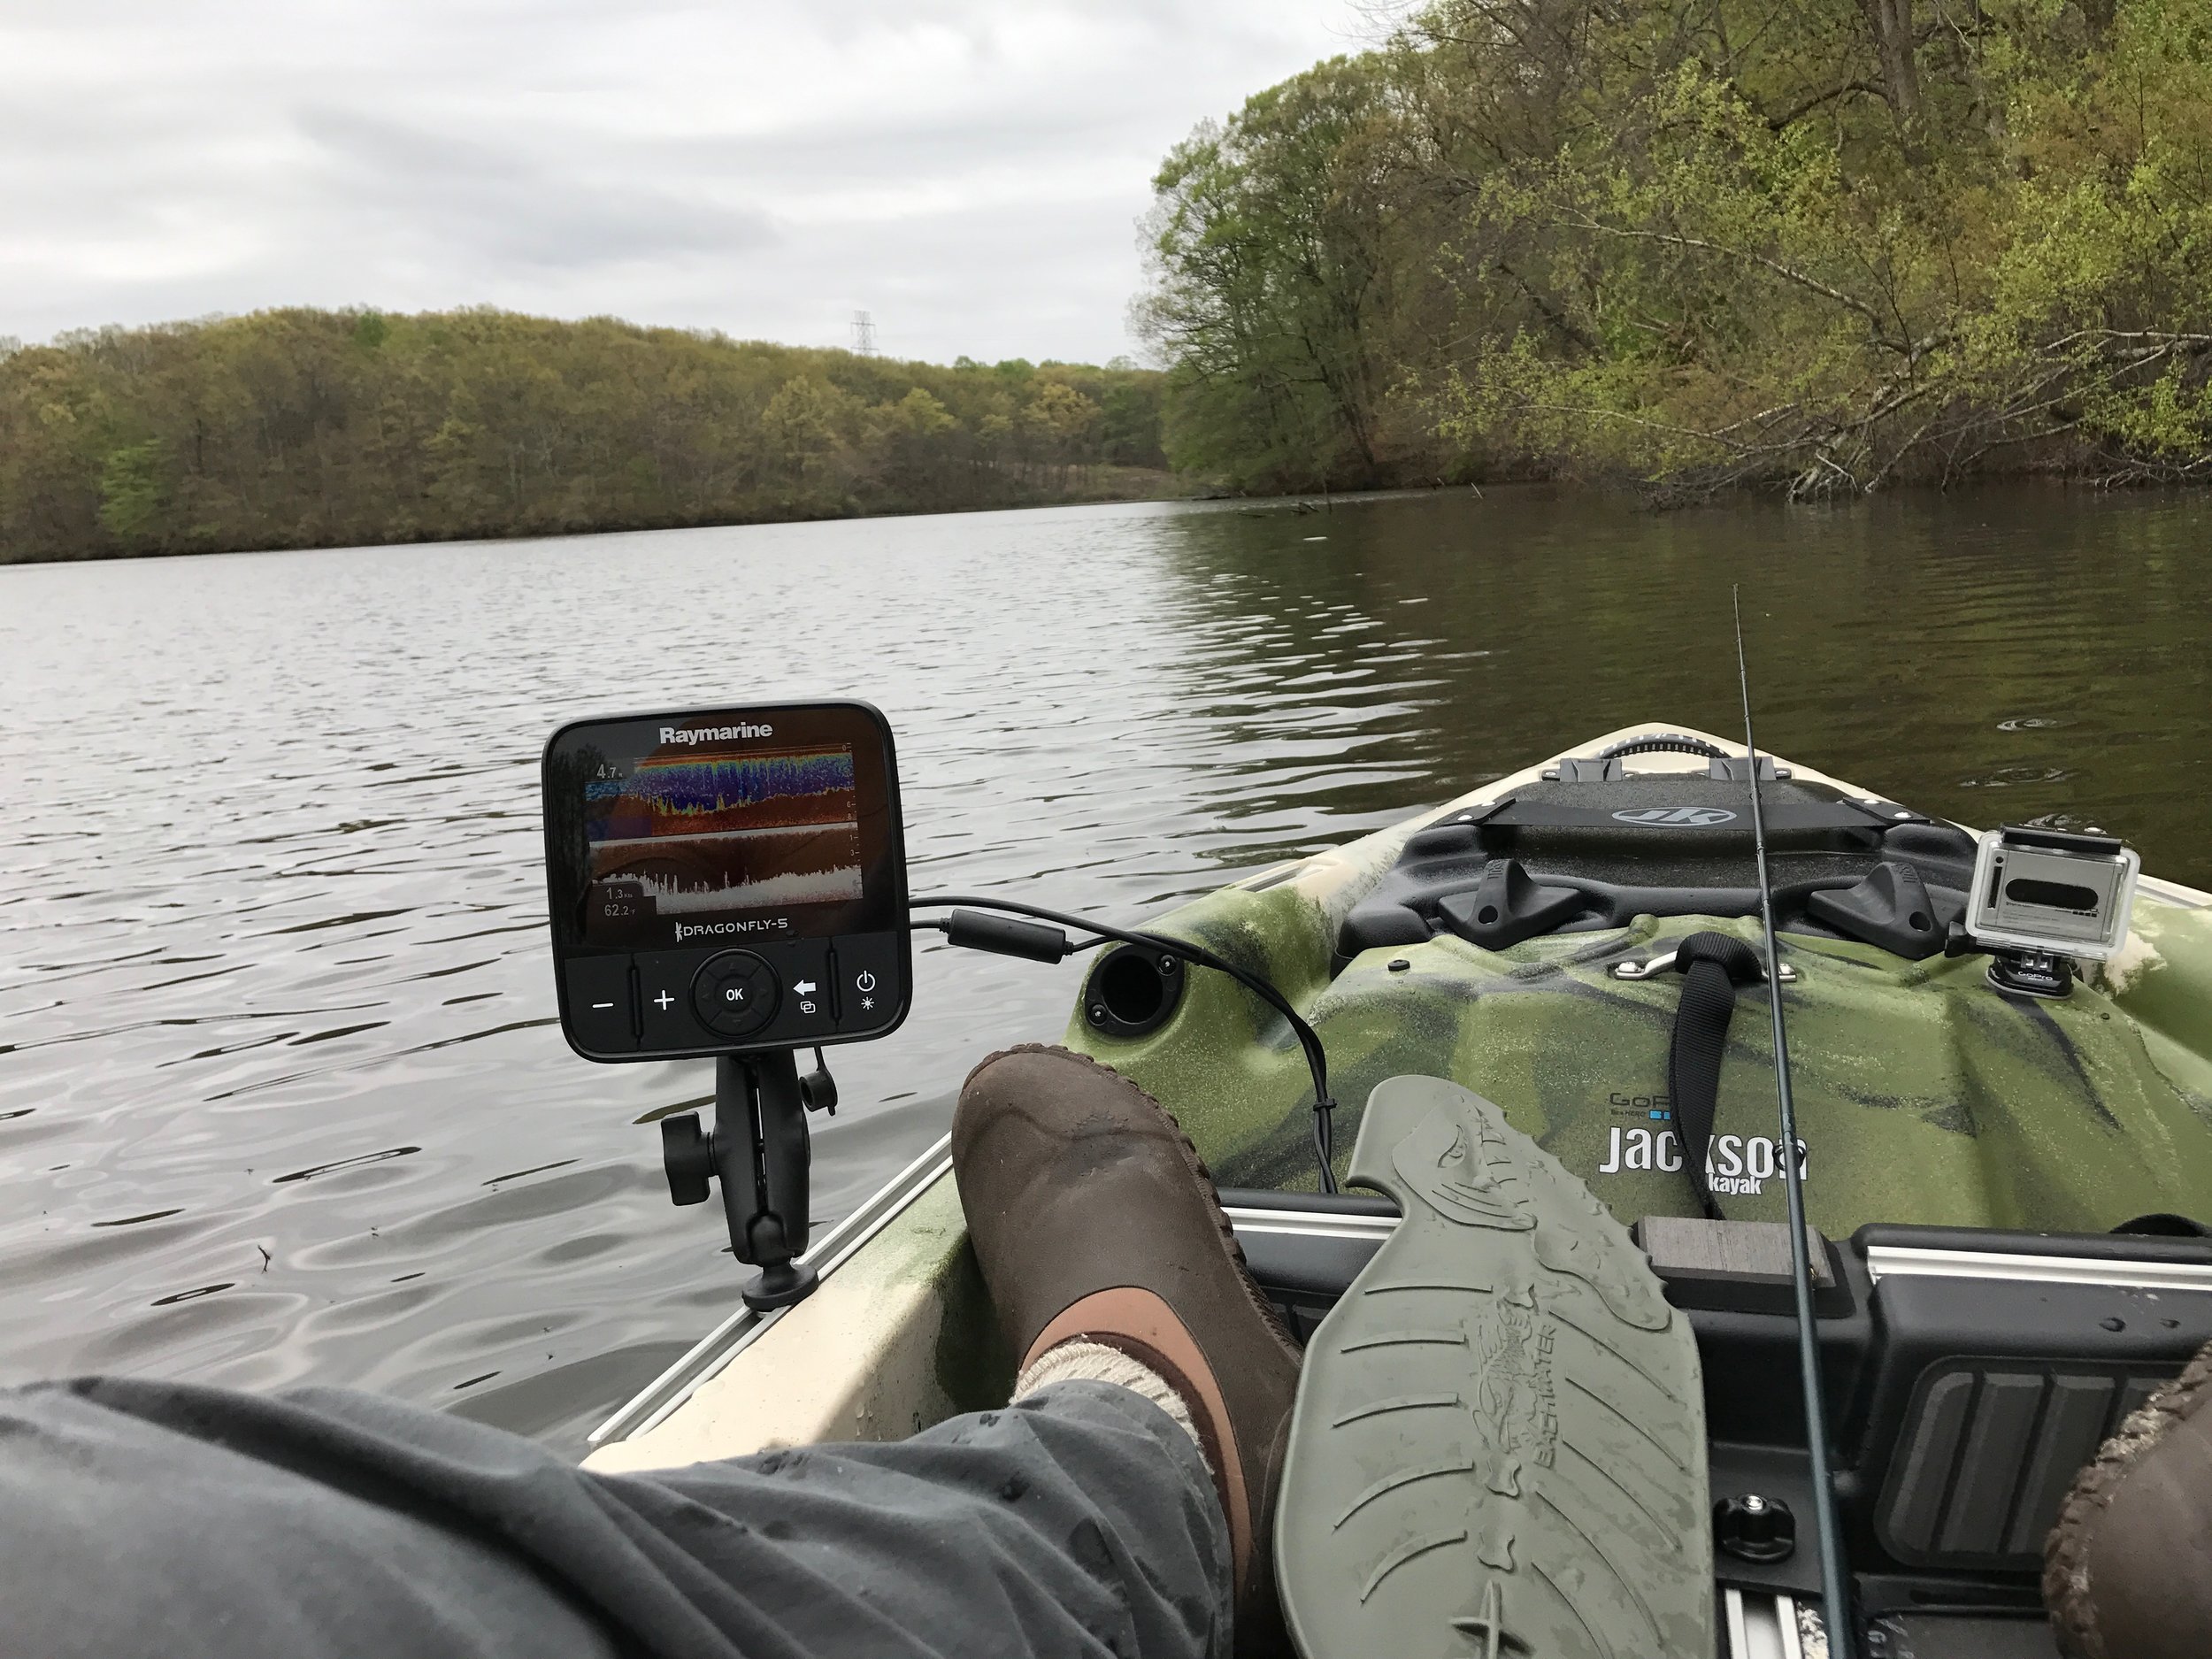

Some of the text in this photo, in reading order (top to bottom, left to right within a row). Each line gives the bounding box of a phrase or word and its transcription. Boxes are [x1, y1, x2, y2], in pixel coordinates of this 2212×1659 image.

[659, 722, 773, 746] Raymarine
[596, 764, 617, 779] 4.7
[606, 887, 624, 900] 1.3
[604, 903, 629, 917] 62.2
[2017, 971, 2054, 981] GoPro
[726, 987, 744, 1002] OK
[1708, 1172, 1763, 1195] kayak
